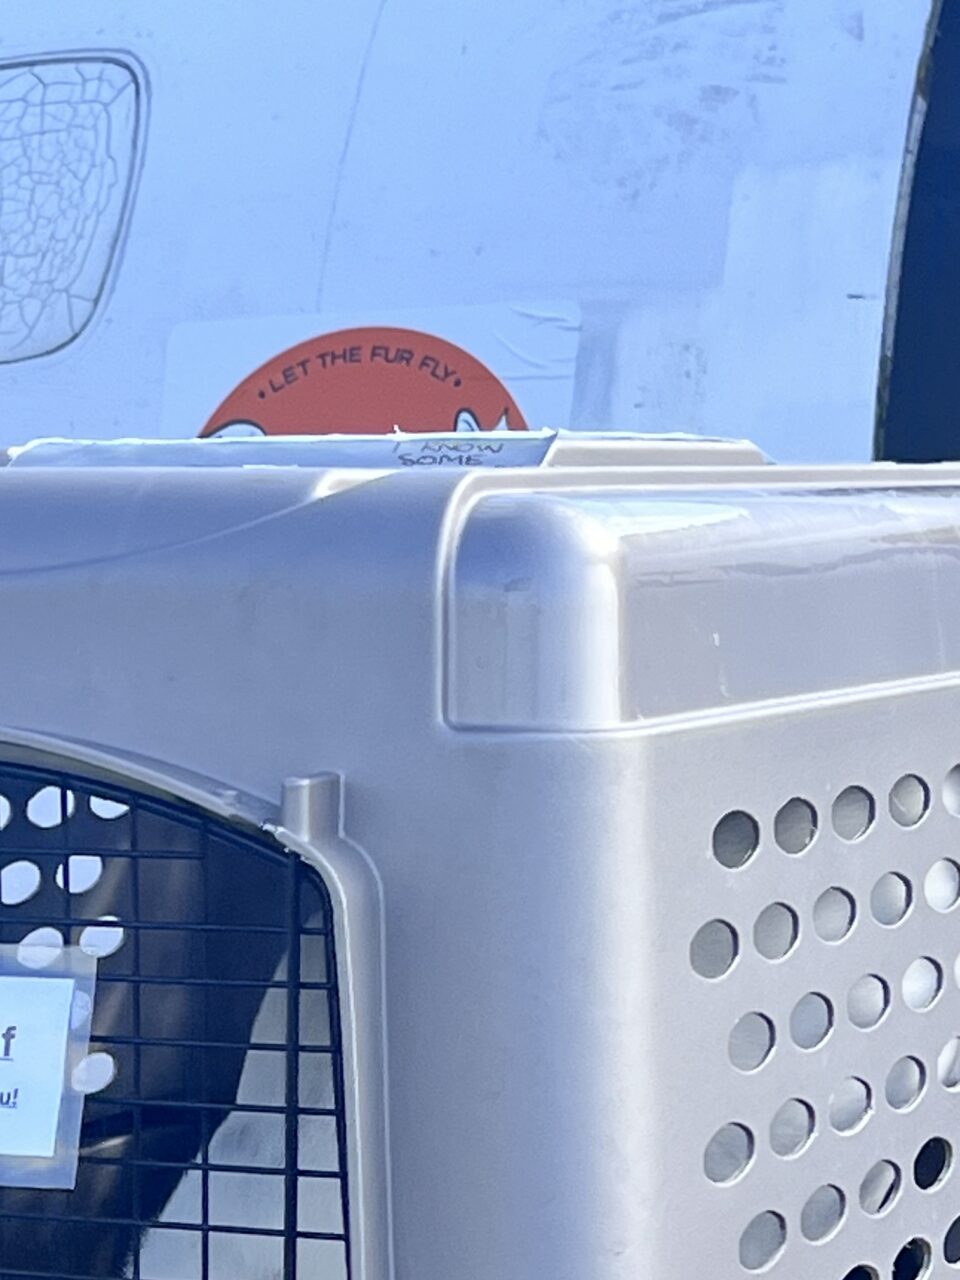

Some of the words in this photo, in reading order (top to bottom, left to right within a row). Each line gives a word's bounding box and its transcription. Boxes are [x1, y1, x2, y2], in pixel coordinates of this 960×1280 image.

[268, 358, 311, 393] LET
[316, 346, 363, 368] THE
[370, 345, 415, 367] FUR
[418, 355, 457, 382] FLY
[420, 441, 505, 454] KNOW
[397, 453, 486, 467] SOME
